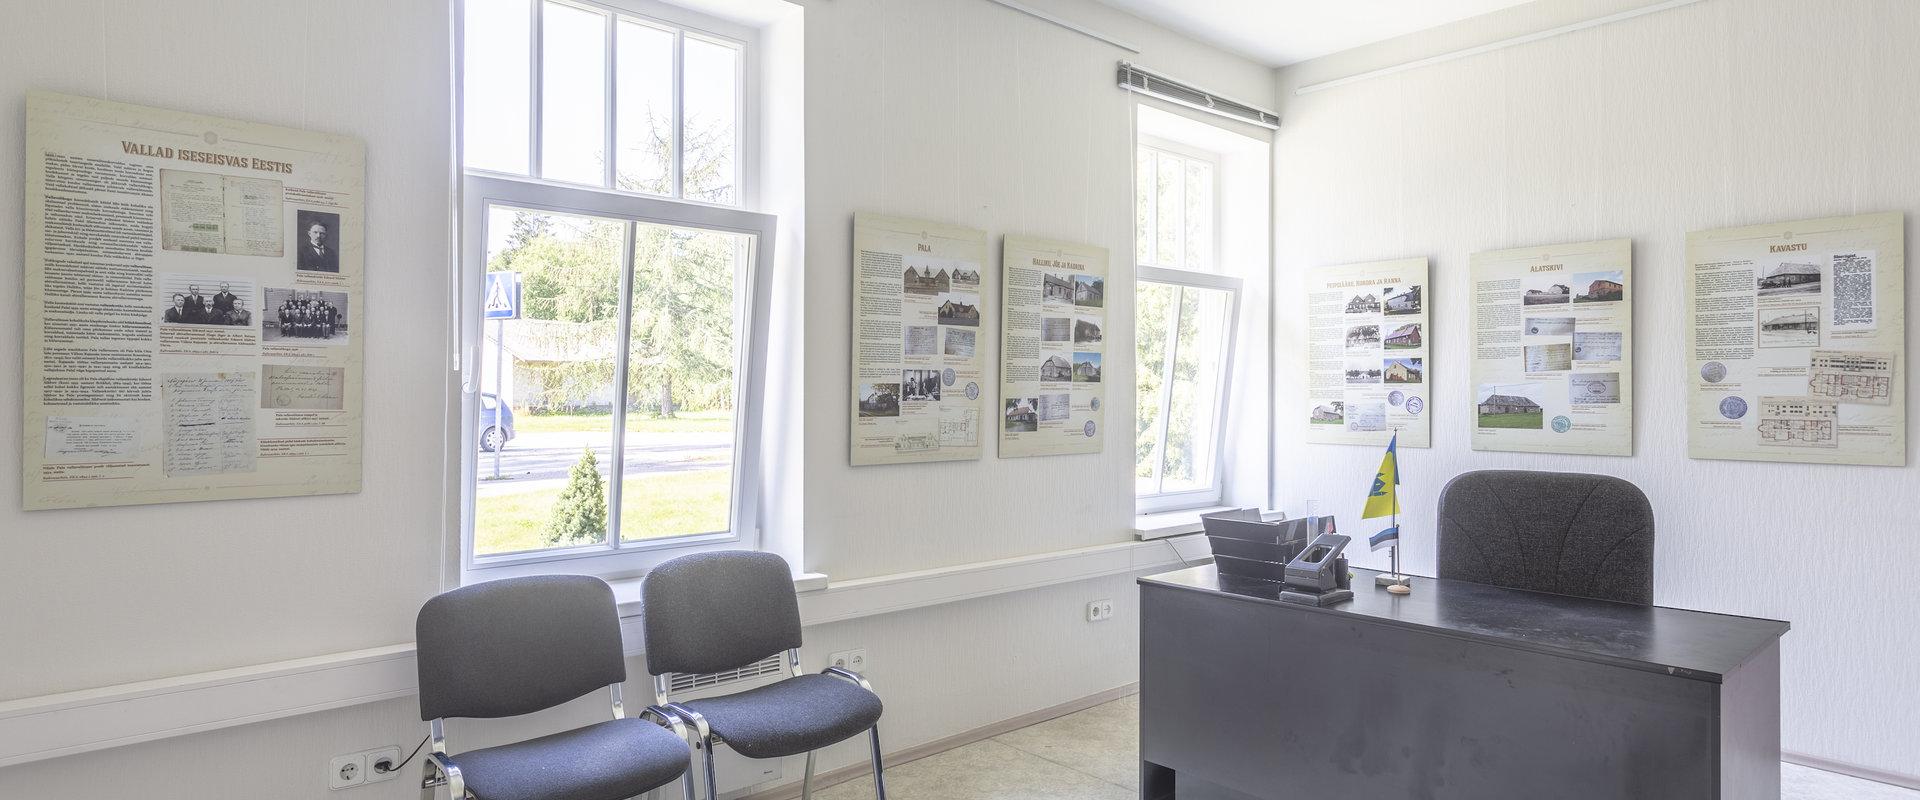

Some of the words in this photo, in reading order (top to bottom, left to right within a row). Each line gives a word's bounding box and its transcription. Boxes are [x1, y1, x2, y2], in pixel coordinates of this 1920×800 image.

[121, 141, 173, 159] VALLAD
[177, 149, 249, 169] ISESEISVAS
[252, 158, 293, 175] EESTIS
[1770, 243, 1807, 253] KAVASTU
[1530, 264, 1563, 273] ALATSKIVI
